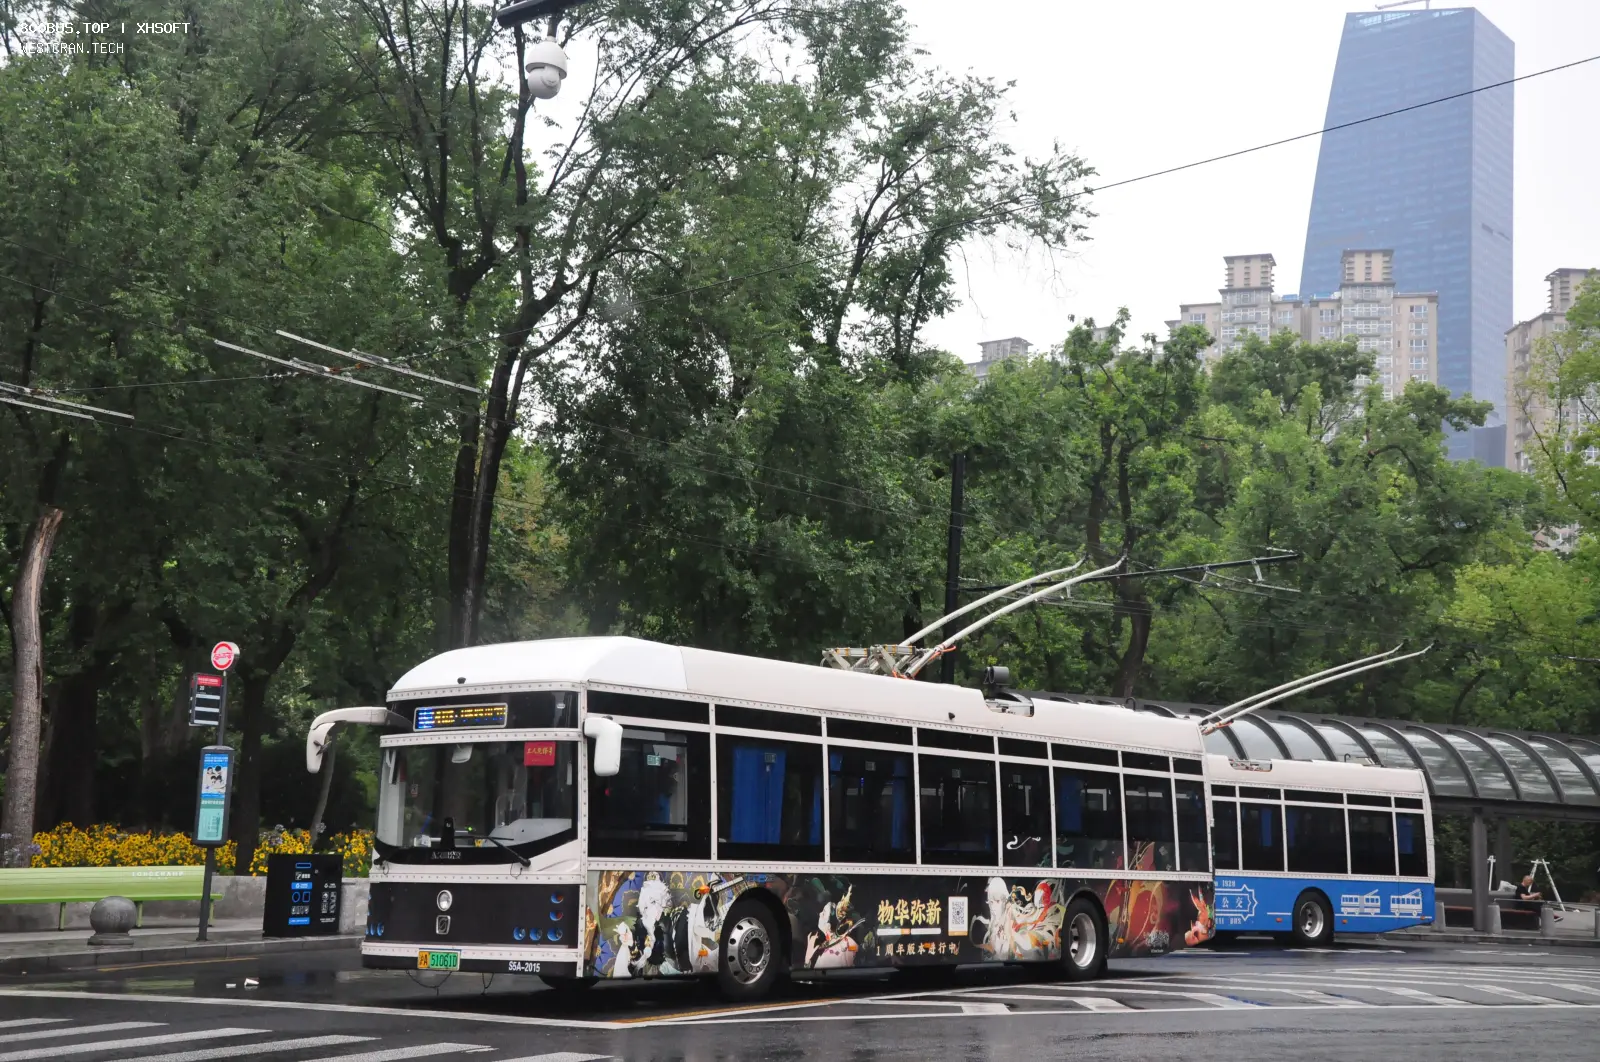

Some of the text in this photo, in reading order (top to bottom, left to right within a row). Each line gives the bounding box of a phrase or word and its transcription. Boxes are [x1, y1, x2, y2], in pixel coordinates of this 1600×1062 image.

[877, 898, 942, 926] 物华弥新
[508, 960, 541, 973] S5A-2015
